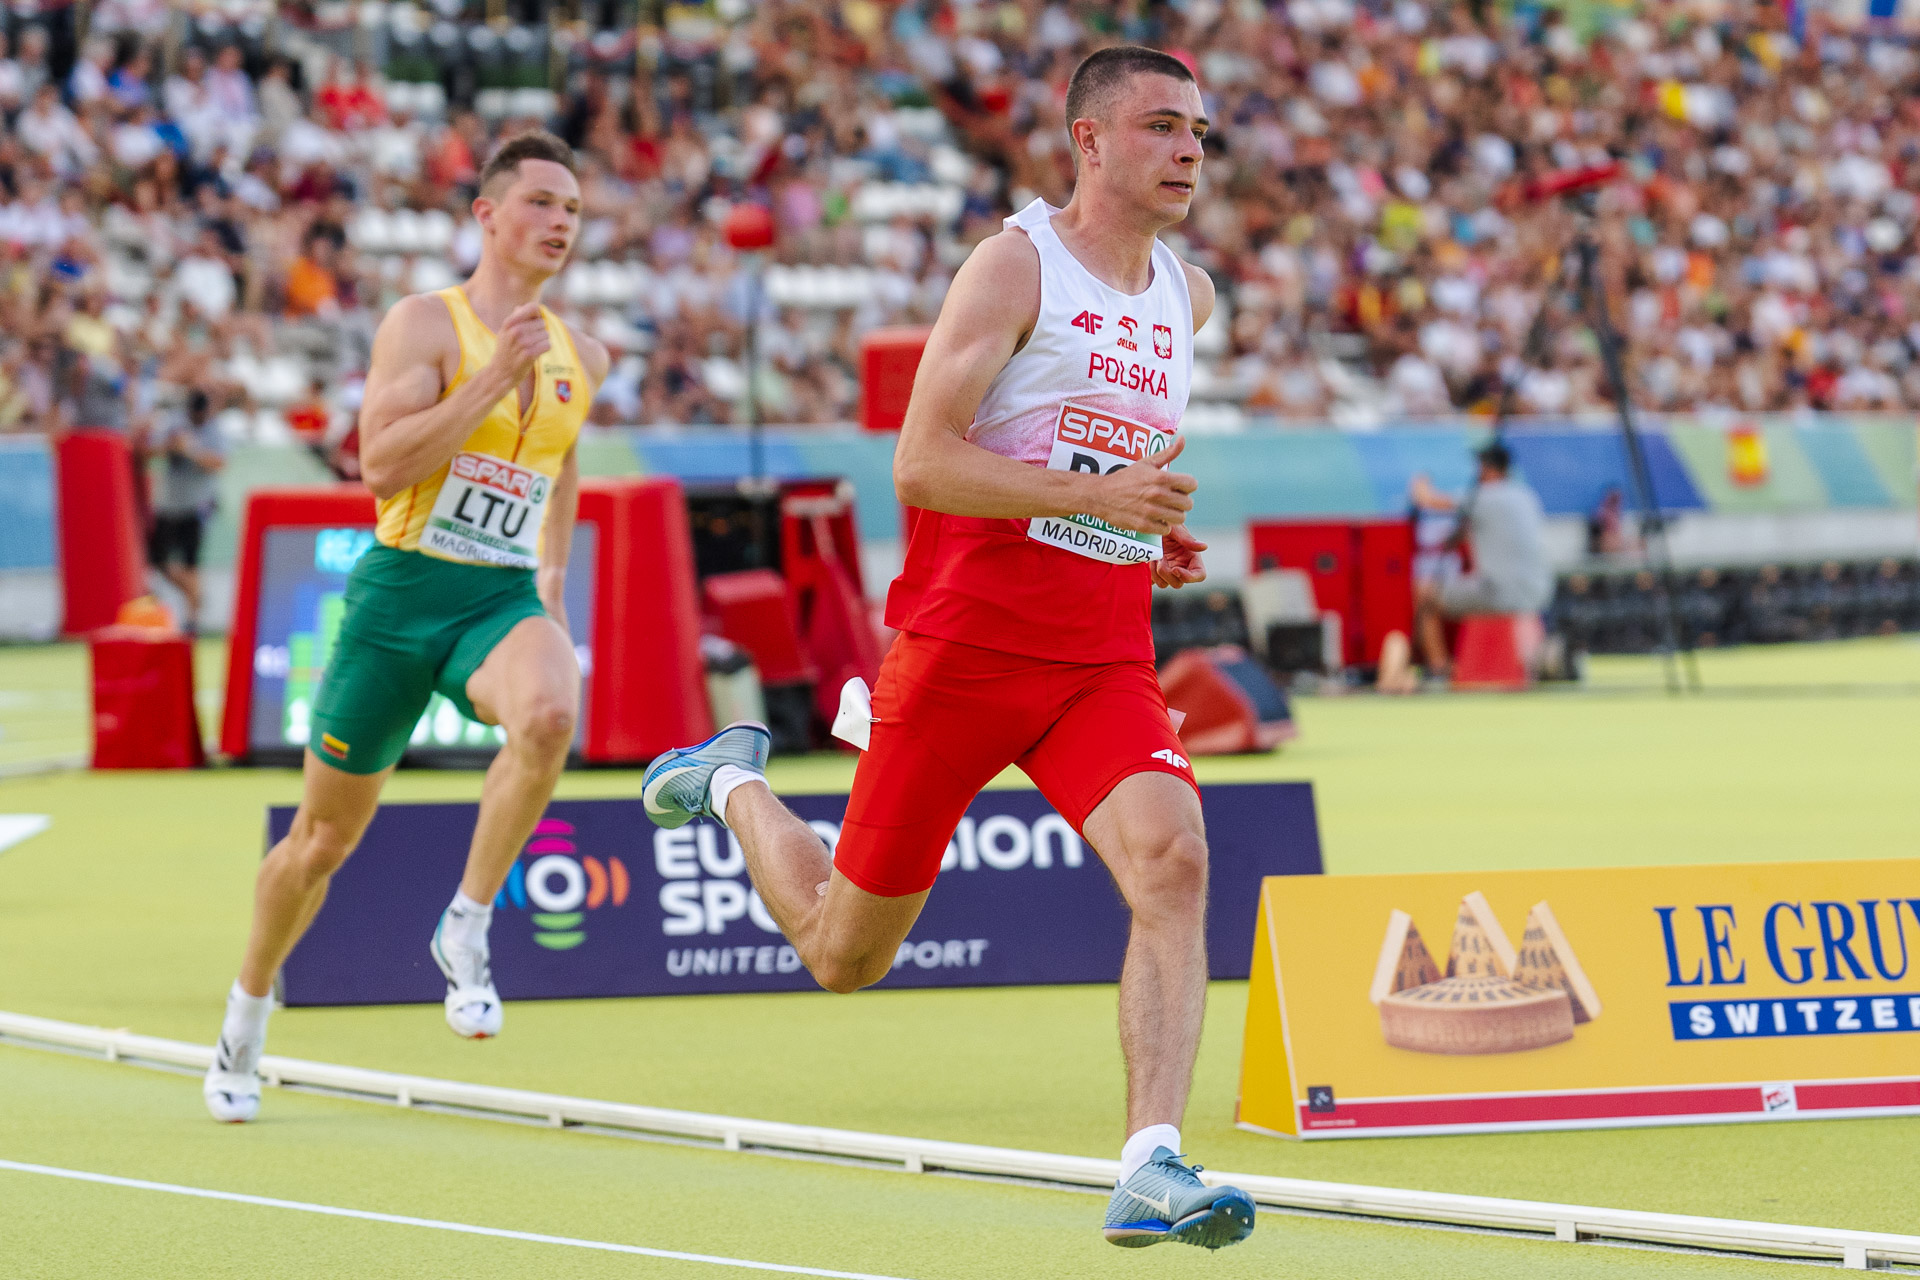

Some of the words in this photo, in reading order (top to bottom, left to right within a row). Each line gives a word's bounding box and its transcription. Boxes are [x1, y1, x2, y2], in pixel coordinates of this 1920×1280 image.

[1071, 310, 1104, 335] 4F
[1117, 337, 1138, 352] ORLEN
[1088, 352, 1168, 399] POLSKA
[1061, 412, 1149, 457] SPAR
[454, 455, 530, 495] SPAR
[453, 487, 529, 538] LTU
[1076, 513, 1104, 528] RUN
[431, 533, 490, 561] MADRID
[1042, 520, 1117, 555] MADRID
[1117, 544, 1153, 562] 2025
[1151, 749, 1189, 768] 4F
[666, 945, 802, 977] UNITED
[893, 939, 989, 969] PORT
[1653, 904, 1745, 987] LE
